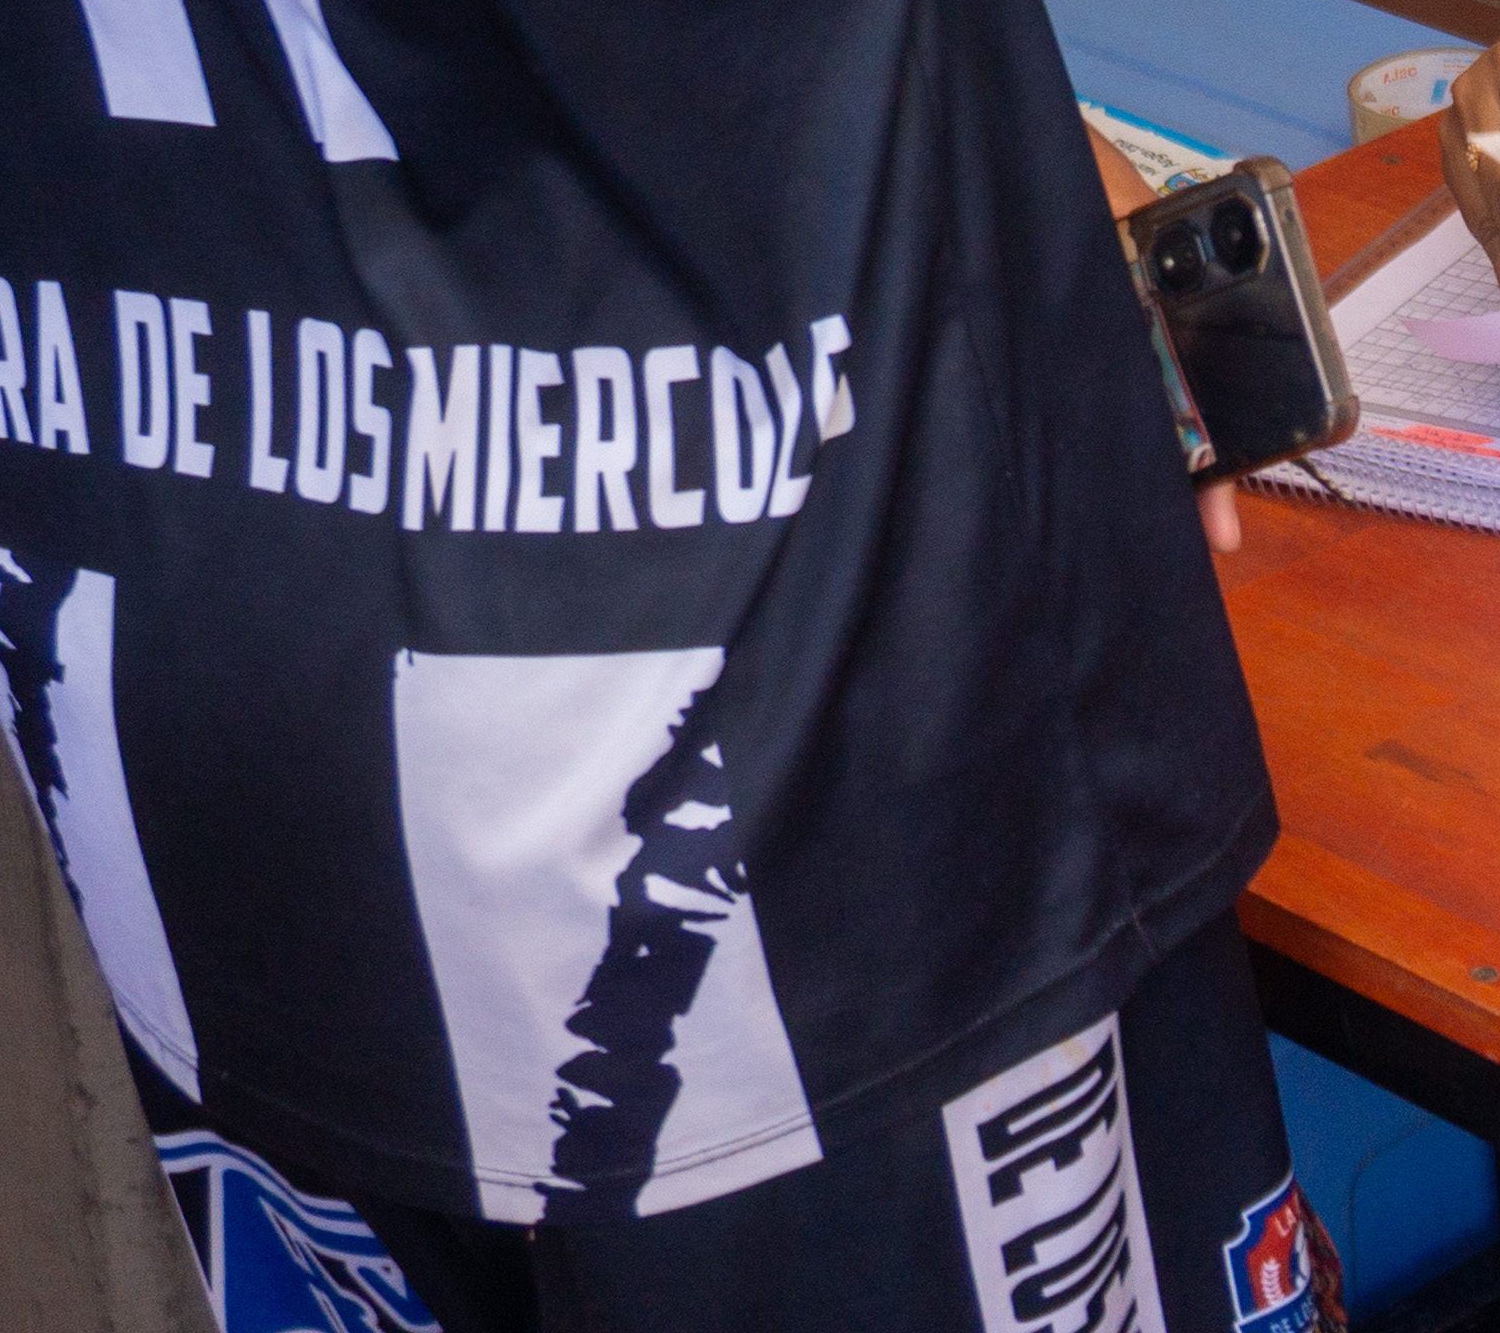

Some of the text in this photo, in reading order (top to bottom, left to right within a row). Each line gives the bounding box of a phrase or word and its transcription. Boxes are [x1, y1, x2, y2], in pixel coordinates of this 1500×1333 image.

[113, 289, 215, 480] DE
[246, 308, 395, 516] LOS
[976, 1033, 1118, 1208] DE
